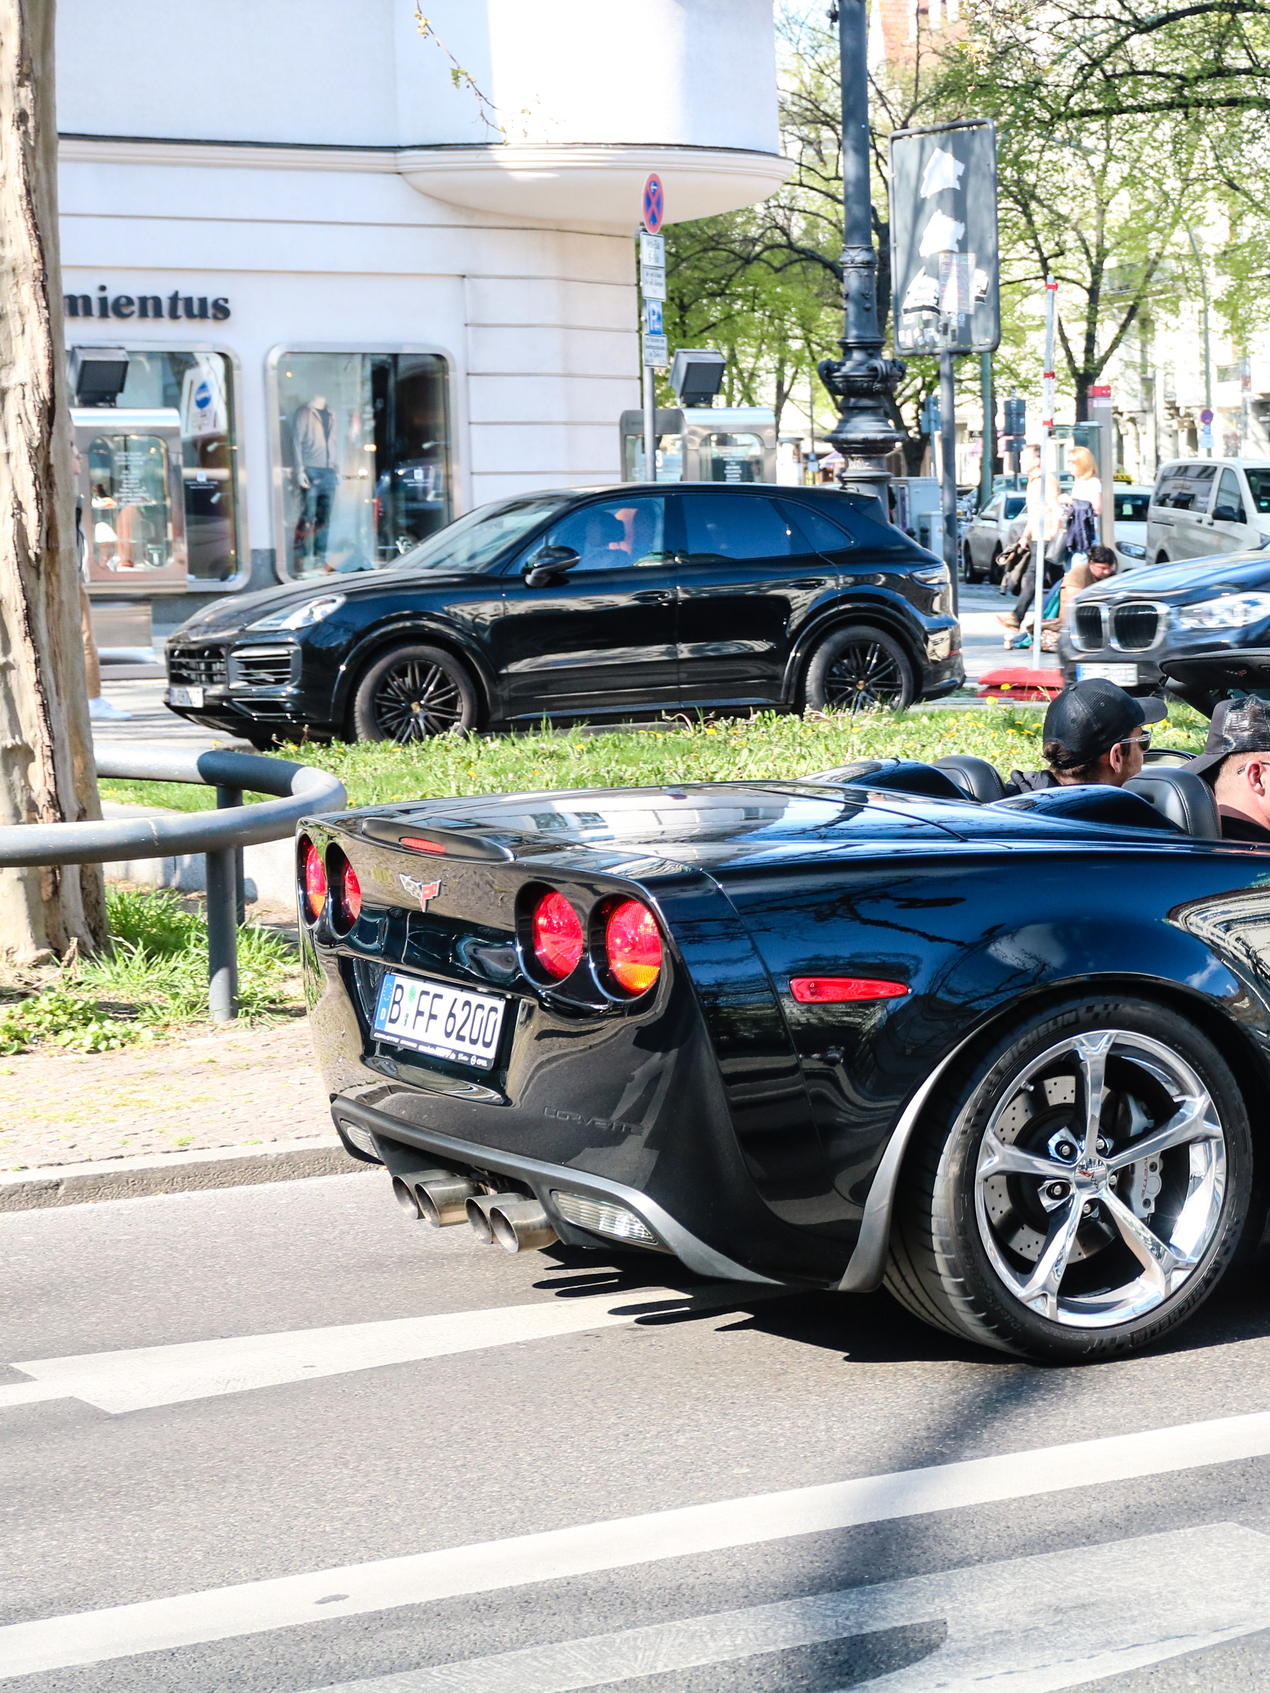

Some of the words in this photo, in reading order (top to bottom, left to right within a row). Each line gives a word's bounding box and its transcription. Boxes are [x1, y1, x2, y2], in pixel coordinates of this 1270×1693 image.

[379, 1008, 386, 1020] D
[388, 984, 404, 1024] B
[412, 990, 443, 1033] FF
[444, 998, 498, 1048] 6200
[999, 1010, 1078, 1071] MICHELIN
[1131, 1280, 1208, 1344] MICHELIN
